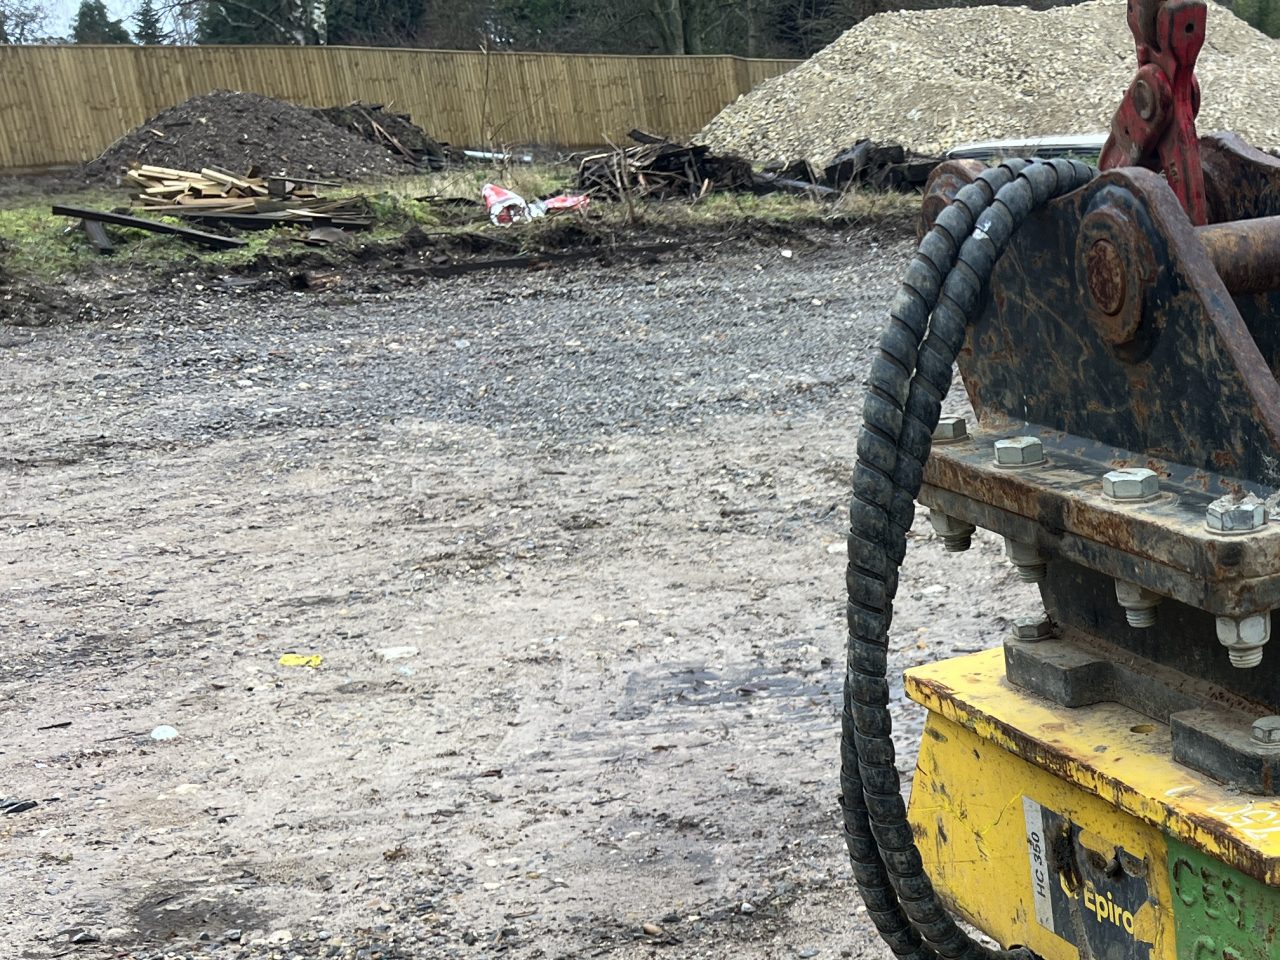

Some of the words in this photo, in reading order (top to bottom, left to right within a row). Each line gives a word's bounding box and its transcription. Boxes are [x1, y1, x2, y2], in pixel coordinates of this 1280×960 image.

[1031, 831, 1043, 866] 350
[1036, 869, 1046, 898] HC
[1083, 880, 1134, 935] Epiro
